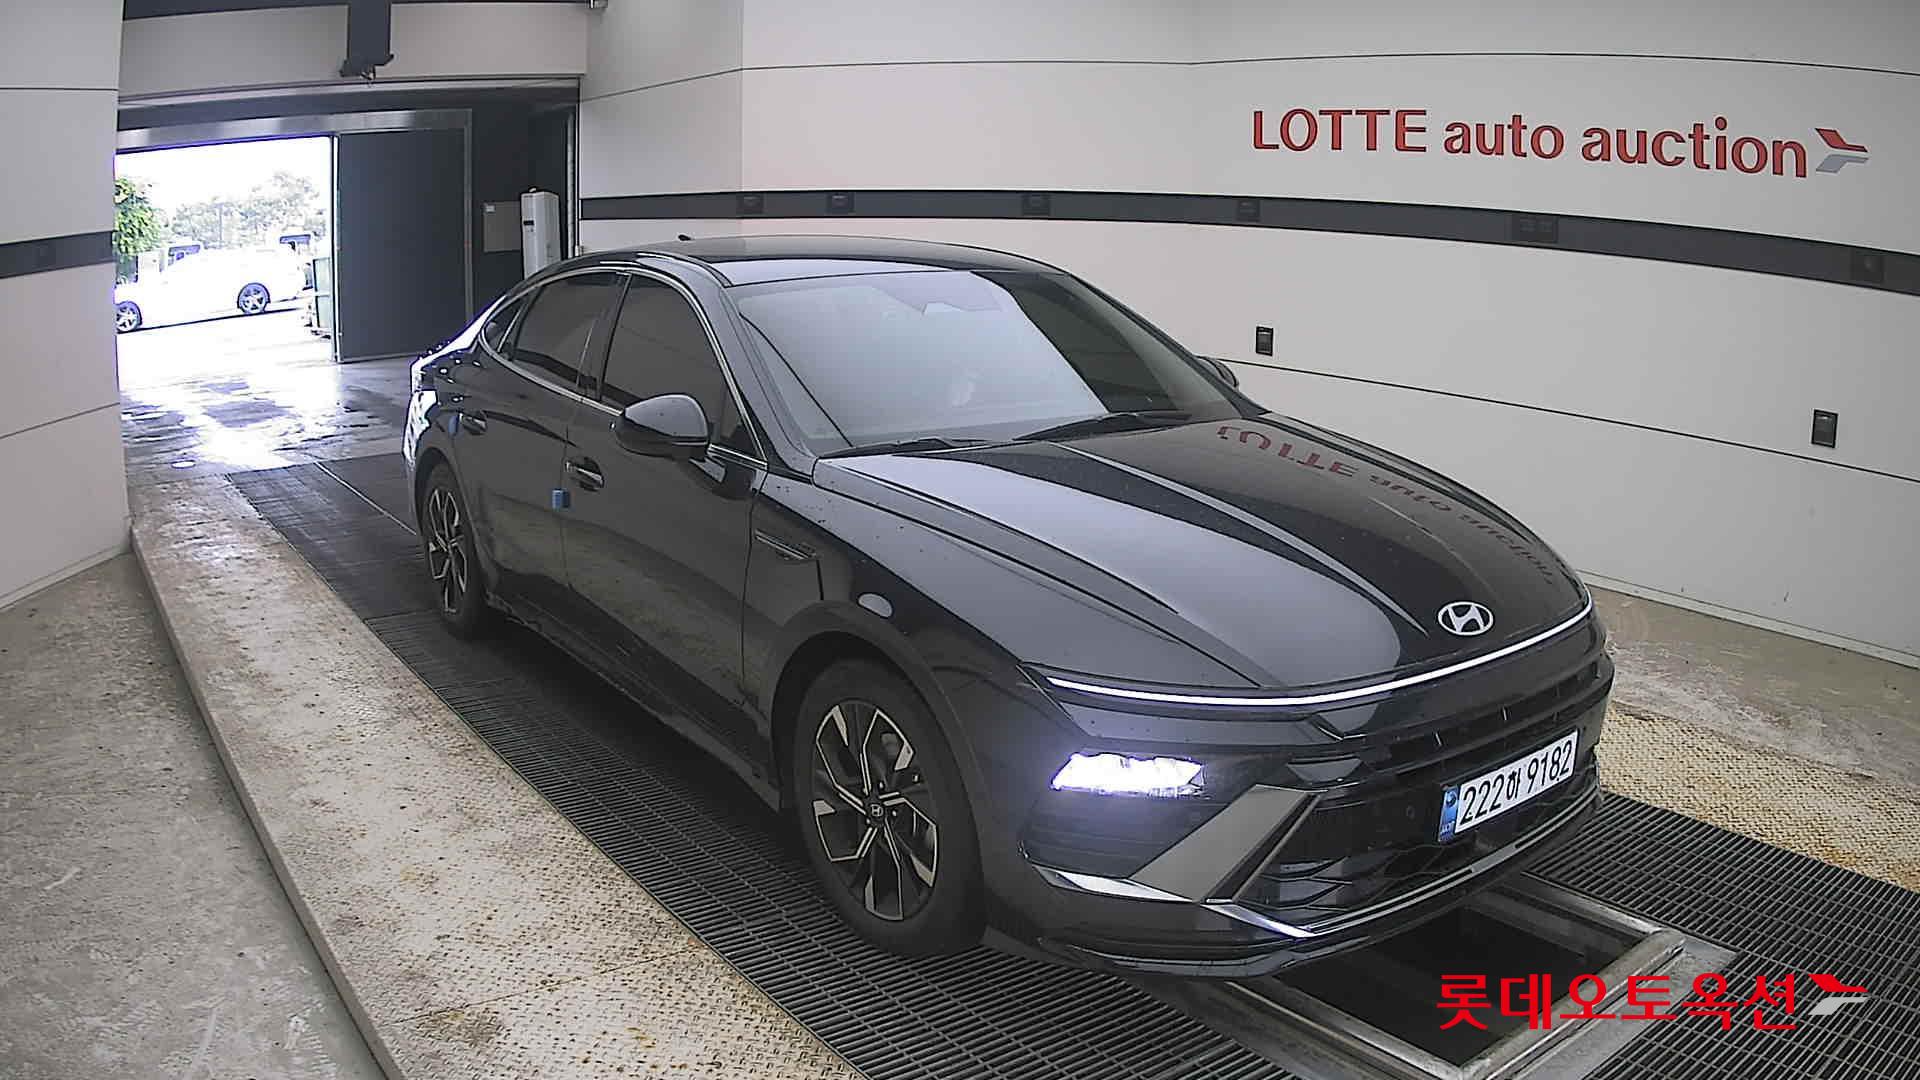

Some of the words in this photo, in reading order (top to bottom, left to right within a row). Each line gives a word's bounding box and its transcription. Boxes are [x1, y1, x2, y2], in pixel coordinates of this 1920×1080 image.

[1253, 109, 1427, 152] LOTTE
[1444, 114, 1565, 159] auto
[1581, 116, 1808, 178] auction
[1459, 769, 1521, 826] 222하
[1527, 740, 1572, 794] 9182
